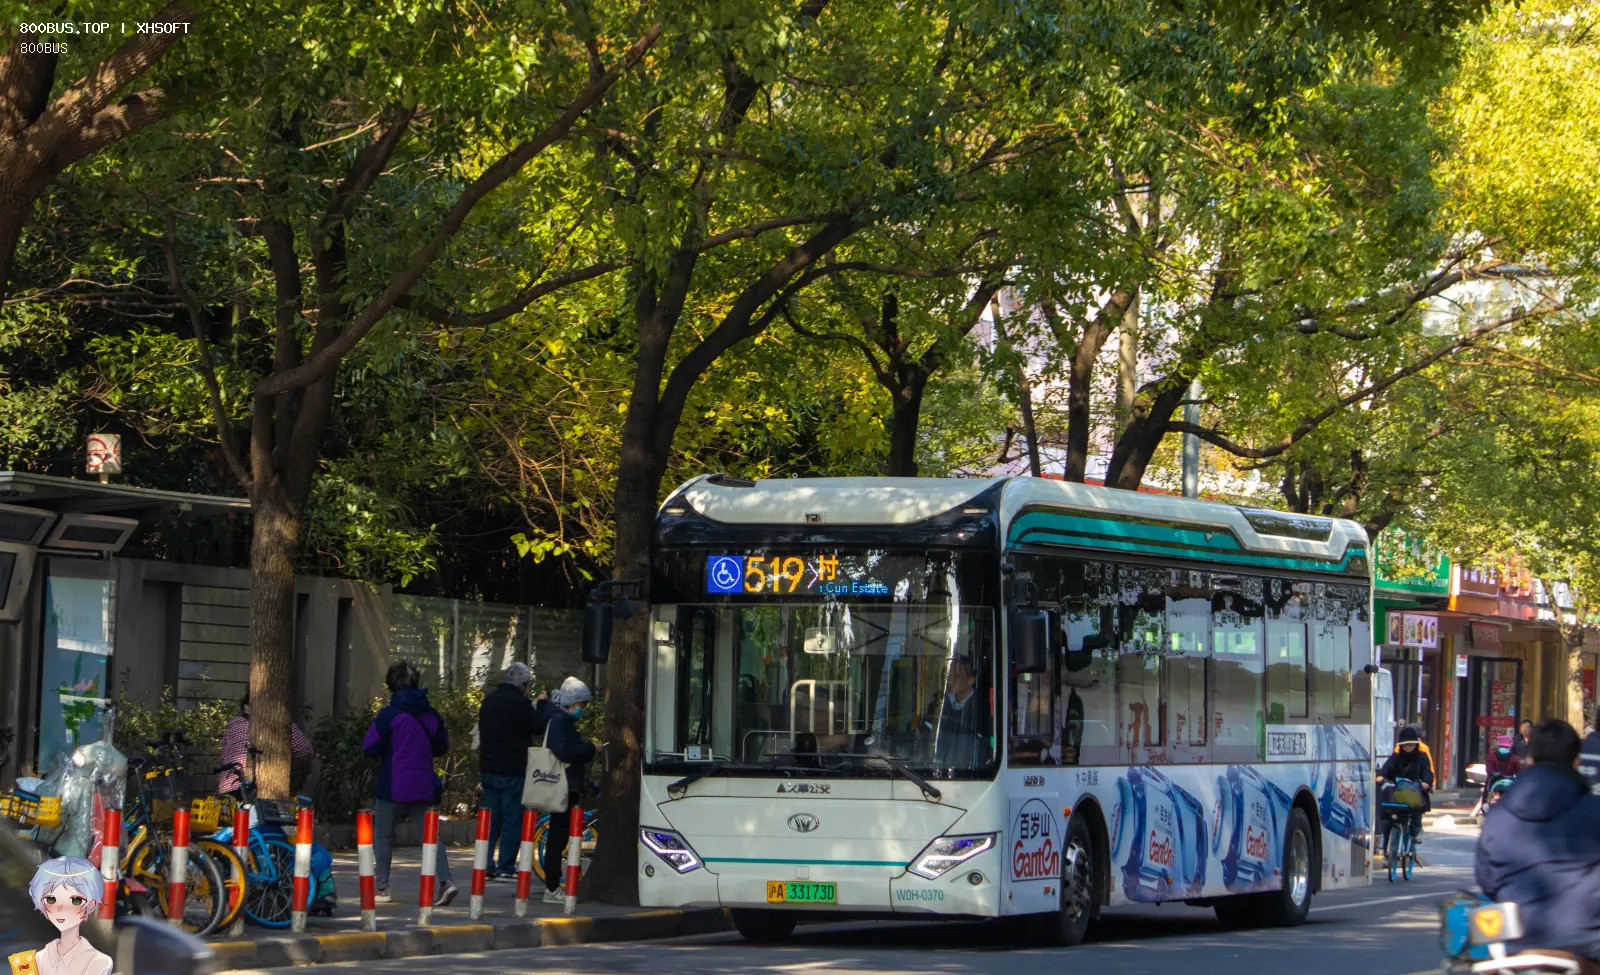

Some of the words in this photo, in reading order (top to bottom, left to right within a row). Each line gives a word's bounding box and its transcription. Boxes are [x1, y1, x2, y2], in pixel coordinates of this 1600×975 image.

[744, 556, 805, 593] 519
[825, 582, 848, 594] Cun
[852, 582, 889, 594] Estate
[532, 769, 561, 780] Original
[1020, 812, 1050, 840] 百岁山
[790, 884, 835, 900] 33173D
